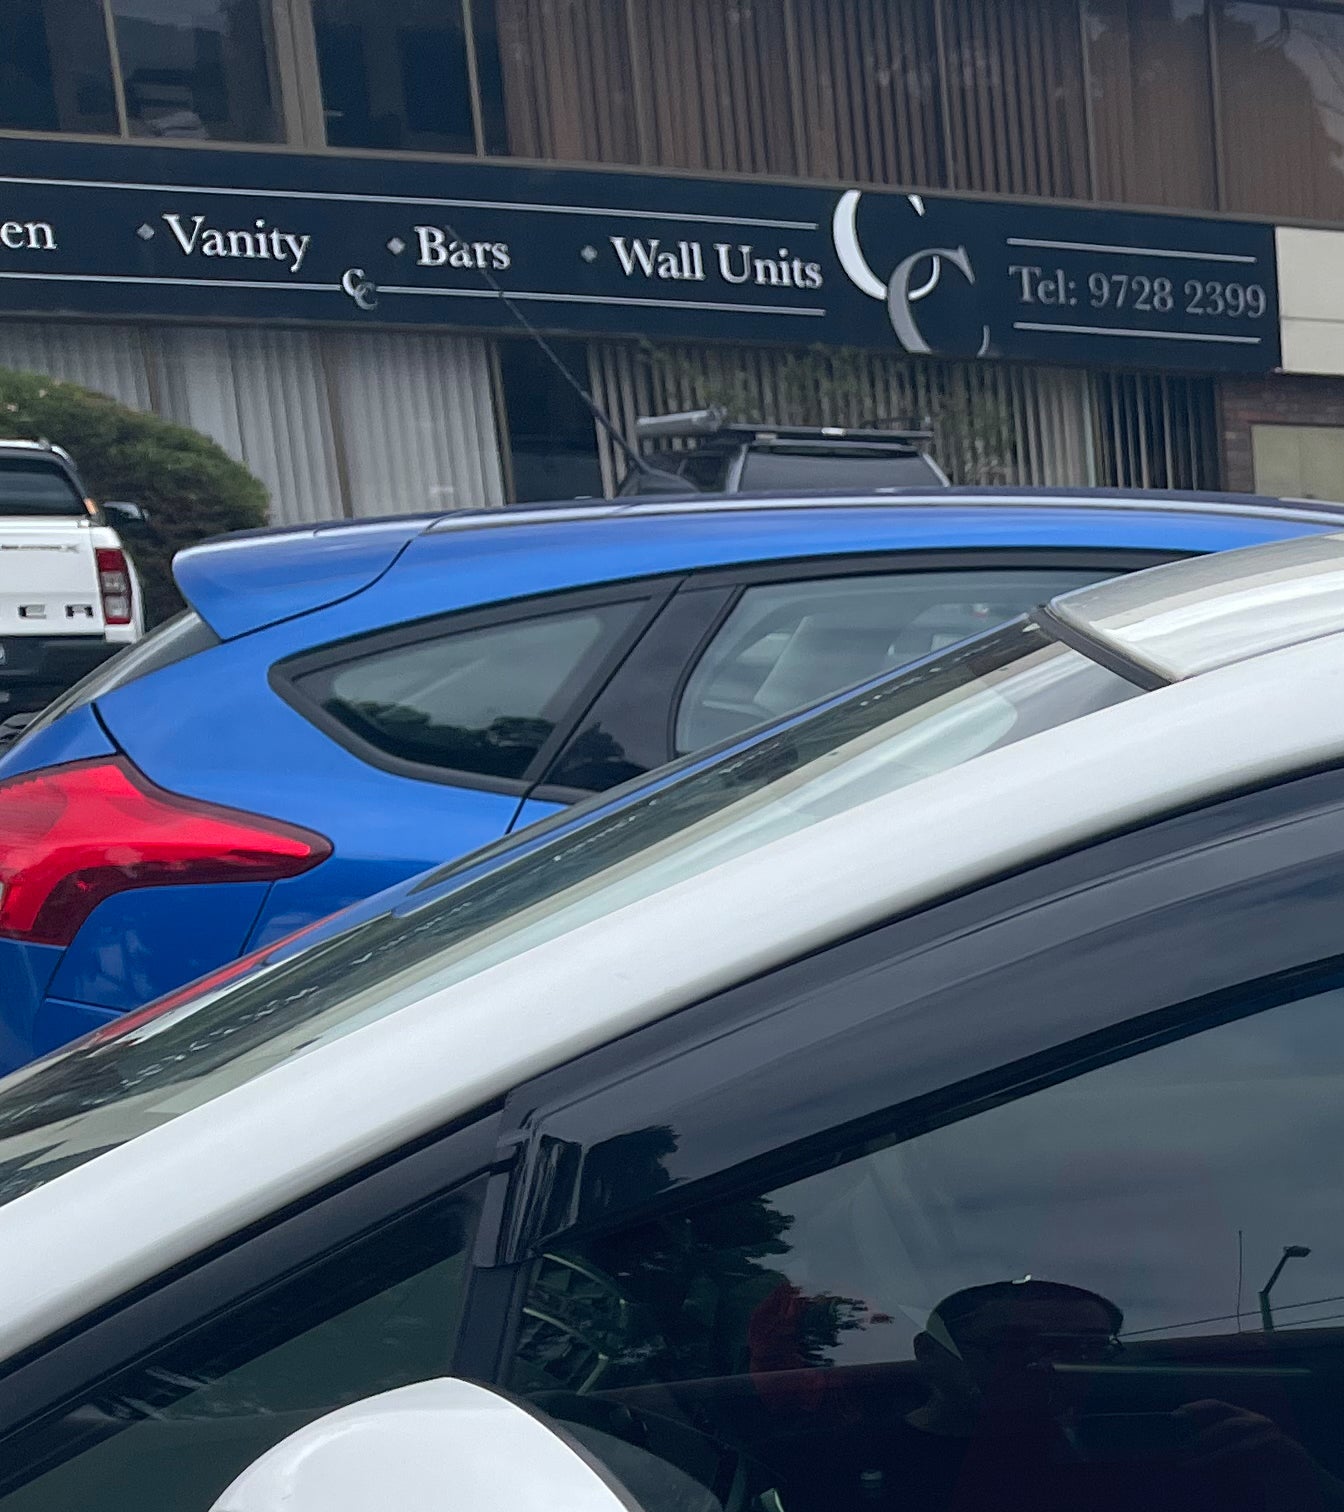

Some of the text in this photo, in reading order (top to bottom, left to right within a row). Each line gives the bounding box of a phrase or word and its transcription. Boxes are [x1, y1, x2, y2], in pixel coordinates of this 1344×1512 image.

[0, 213, 824, 289] en Vanity Bars Wall Units
[1008, 265, 1267, 319] Tel: 9728 2399
